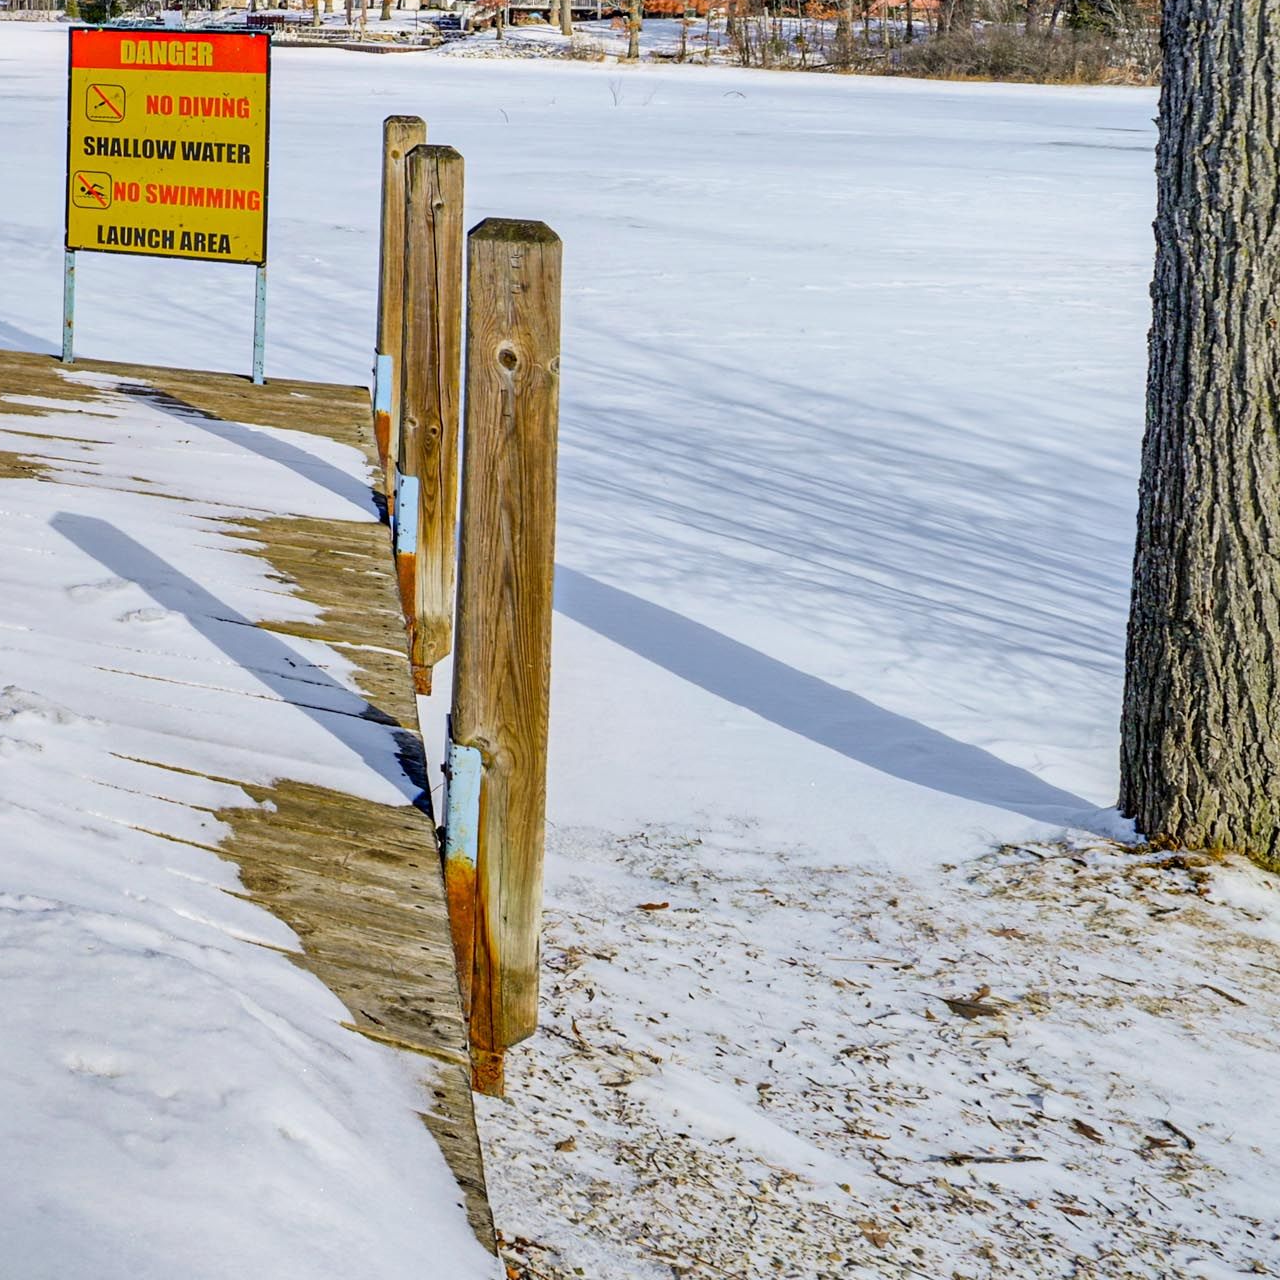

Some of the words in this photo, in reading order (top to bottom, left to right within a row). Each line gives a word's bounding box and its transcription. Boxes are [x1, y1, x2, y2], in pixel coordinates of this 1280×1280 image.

[120, 40, 214, 67] DANGER
[146, 94, 173, 115] NO
[178, 96, 251, 119] DIVING
[83, 136, 176, 160] SHALLOW
[181, 141, 251, 164] WATER
[113, 181, 140, 203] NO
[145, 183, 261, 211] SWIMMING
[97, 225, 175, 250] LAUNCH
[179, 231, 232, 254] AREA
